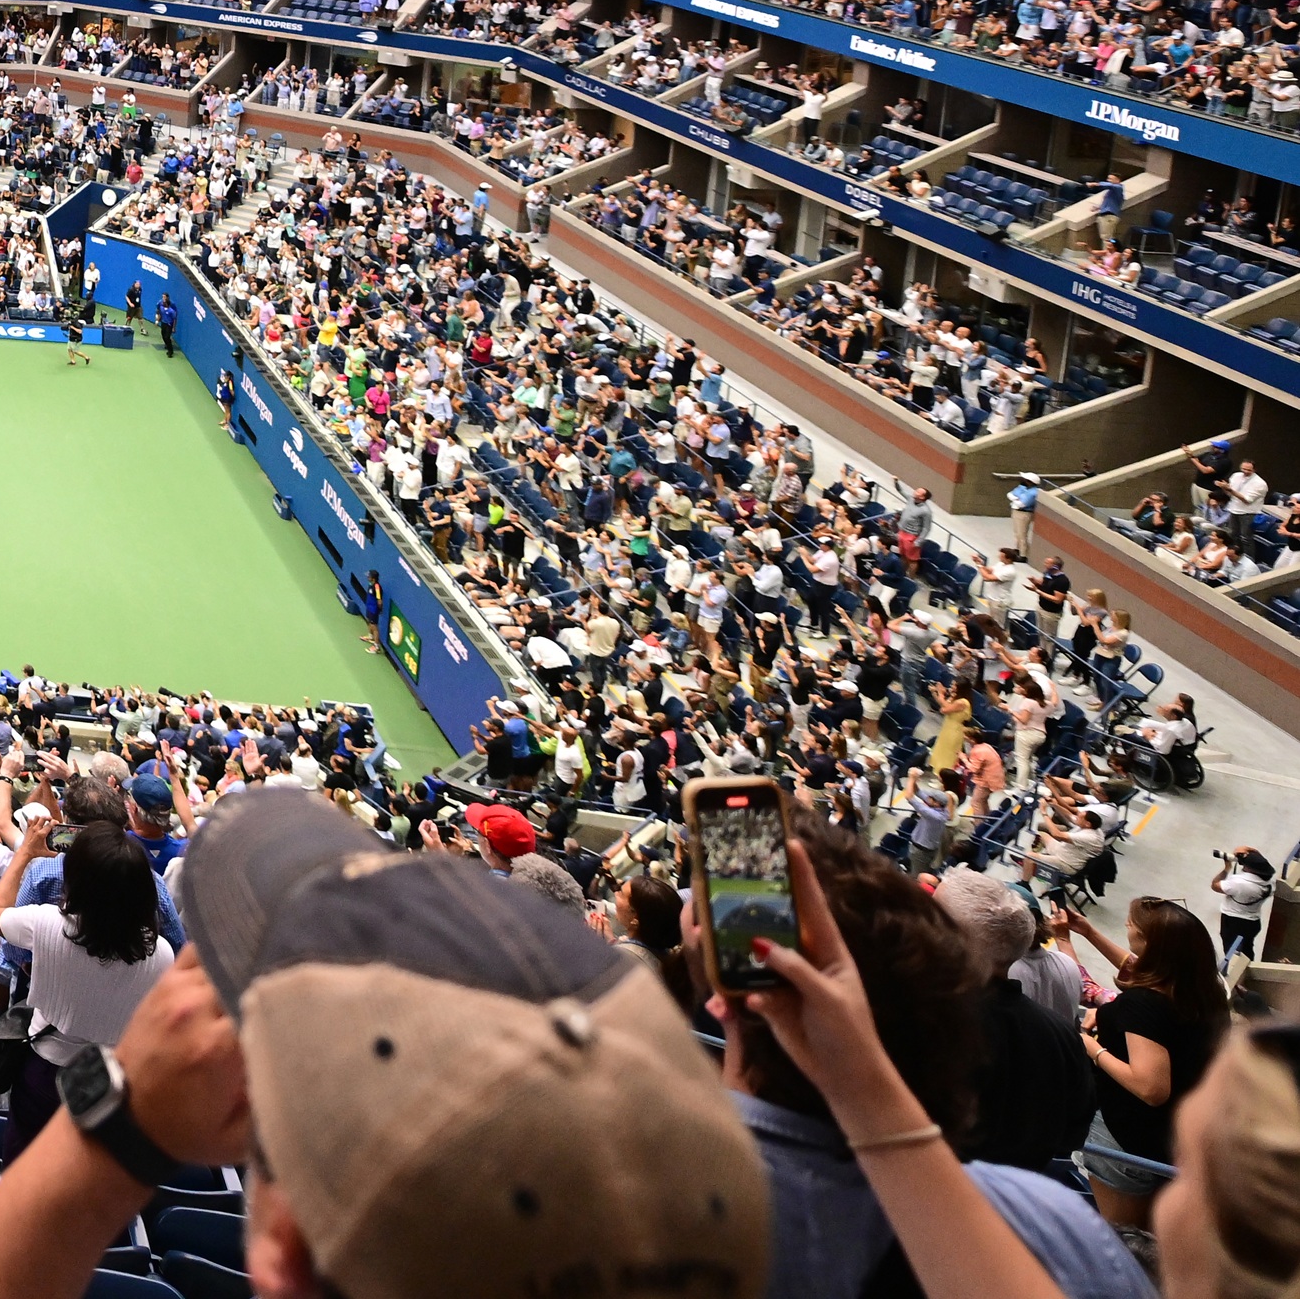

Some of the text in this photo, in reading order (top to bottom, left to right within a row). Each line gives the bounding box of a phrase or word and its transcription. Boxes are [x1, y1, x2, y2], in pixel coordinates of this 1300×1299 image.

[218, 13, 303, 32] AMERICAN EXPRESS
[850, 35, 937, 72] Emirates Airline
[565, 73, 607, 98] CADILLAC
[1085, 99, 1180, 142] J.P.Morgan
[688, 124, 730, 149] CHUBB
[844, 183, 884, 209] DOBEL
[1072, 280, 1102, 305] IHG
[240, 372, 273, 427] J.P.Morgan
[320, 478, 365, 550] J.P.Morgan
